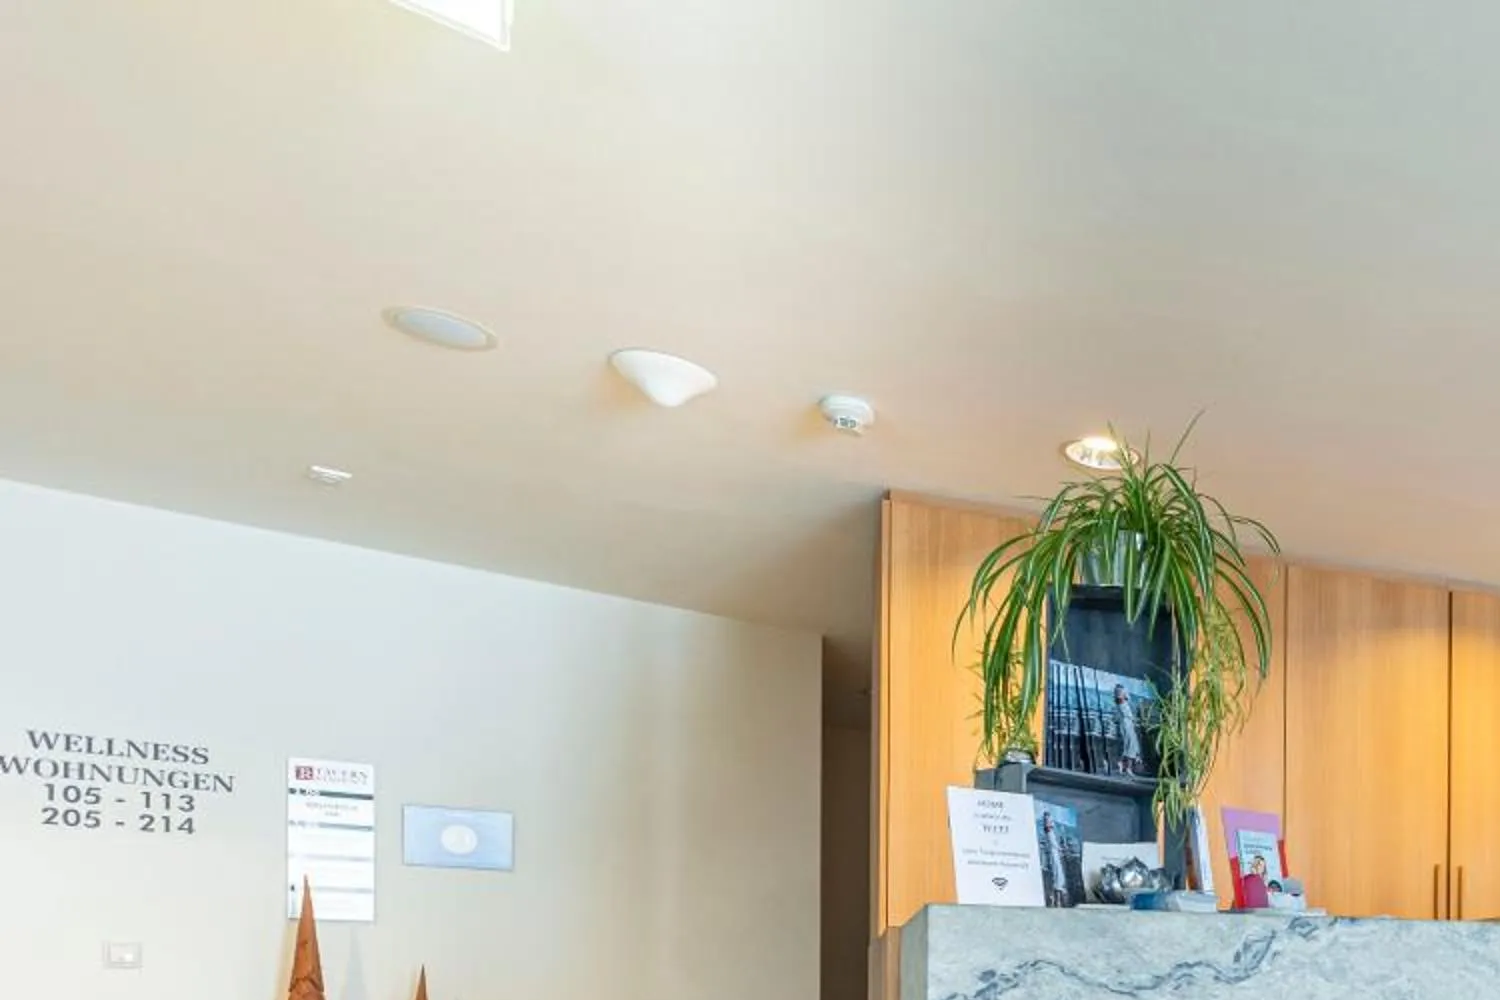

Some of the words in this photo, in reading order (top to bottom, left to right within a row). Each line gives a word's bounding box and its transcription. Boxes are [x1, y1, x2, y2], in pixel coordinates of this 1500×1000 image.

[27, 730, 210, 765] WELLNESS
[0, 754, 236, 793] WOHNUNGEN
[43, 783, 102, 805] 105
[141, 791, 196, 813] 113
[40, 807, 102, 829] 205
[138, 814, 196, 835] 214
